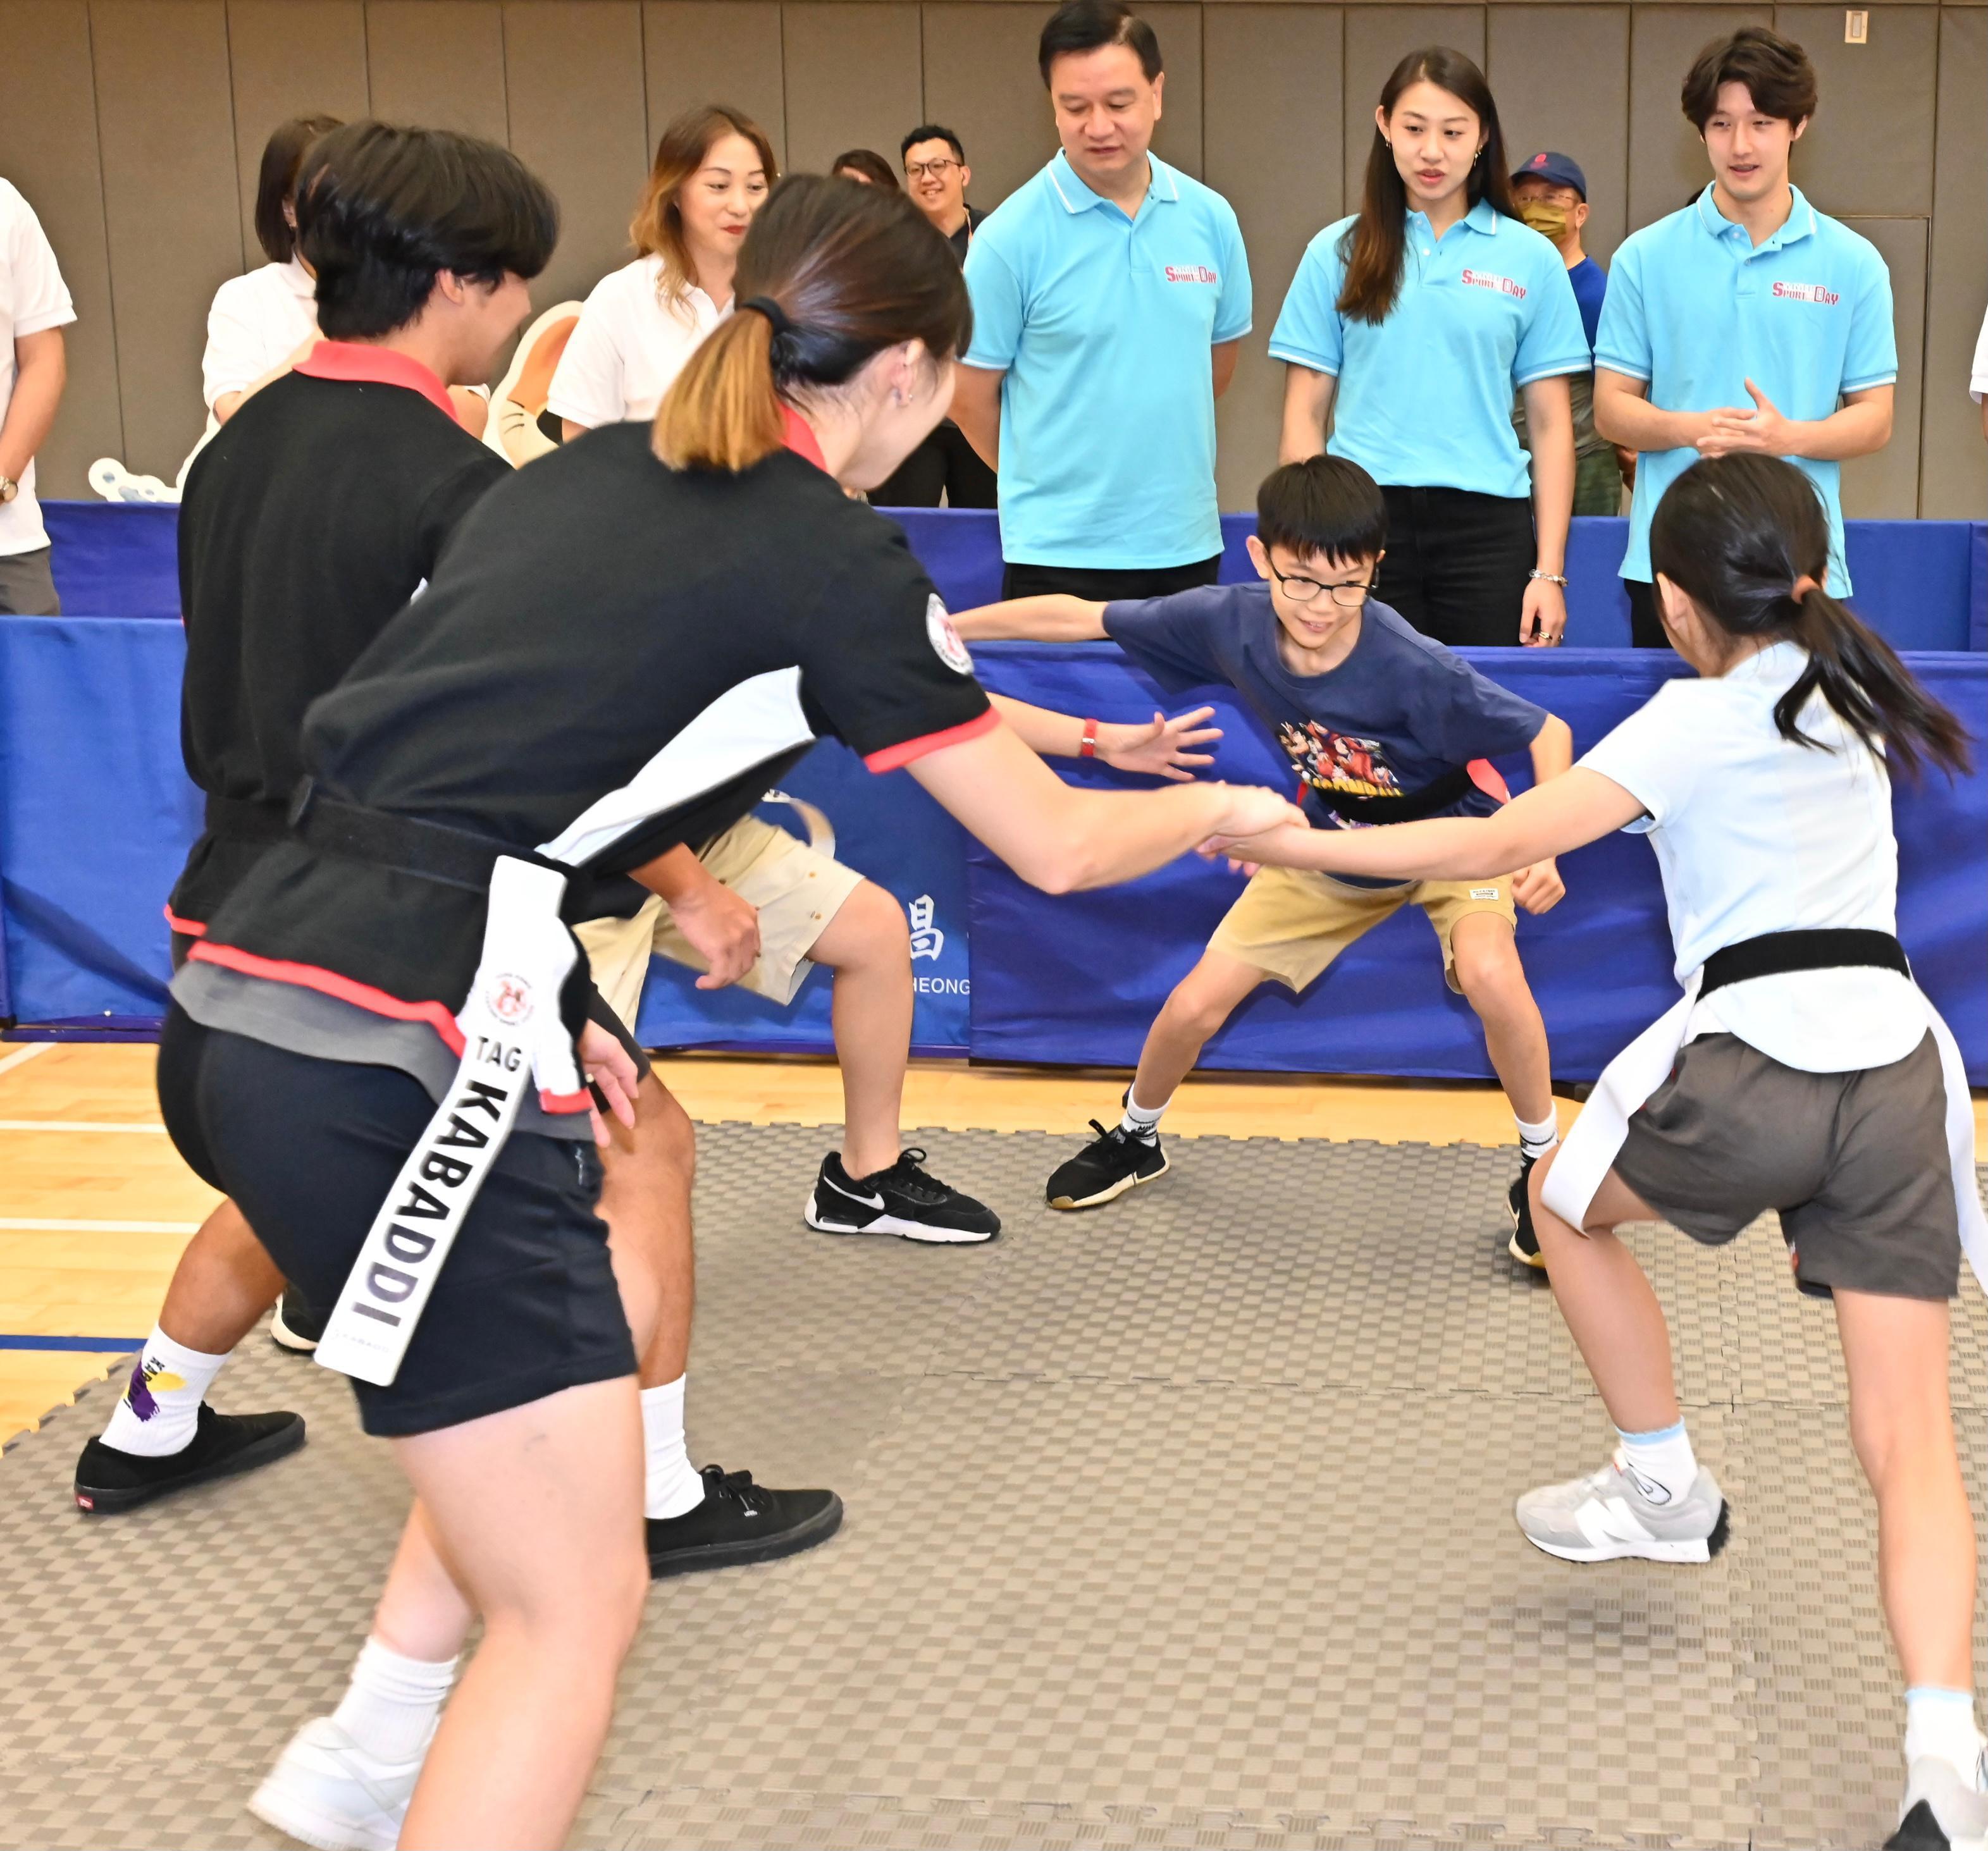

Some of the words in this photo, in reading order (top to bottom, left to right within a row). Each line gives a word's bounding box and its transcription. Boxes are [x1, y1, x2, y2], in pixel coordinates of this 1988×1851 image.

[1199, 266, 1216, 283] DAY
[1503, 278, 1526, 298] DAY
[1814, 286, 1839, 305] DAY
[909, 894, 944, 961] 昌
[475, 1035, 522, 1073] TAG
[351, 1079, 509, 1328] KABADDI
